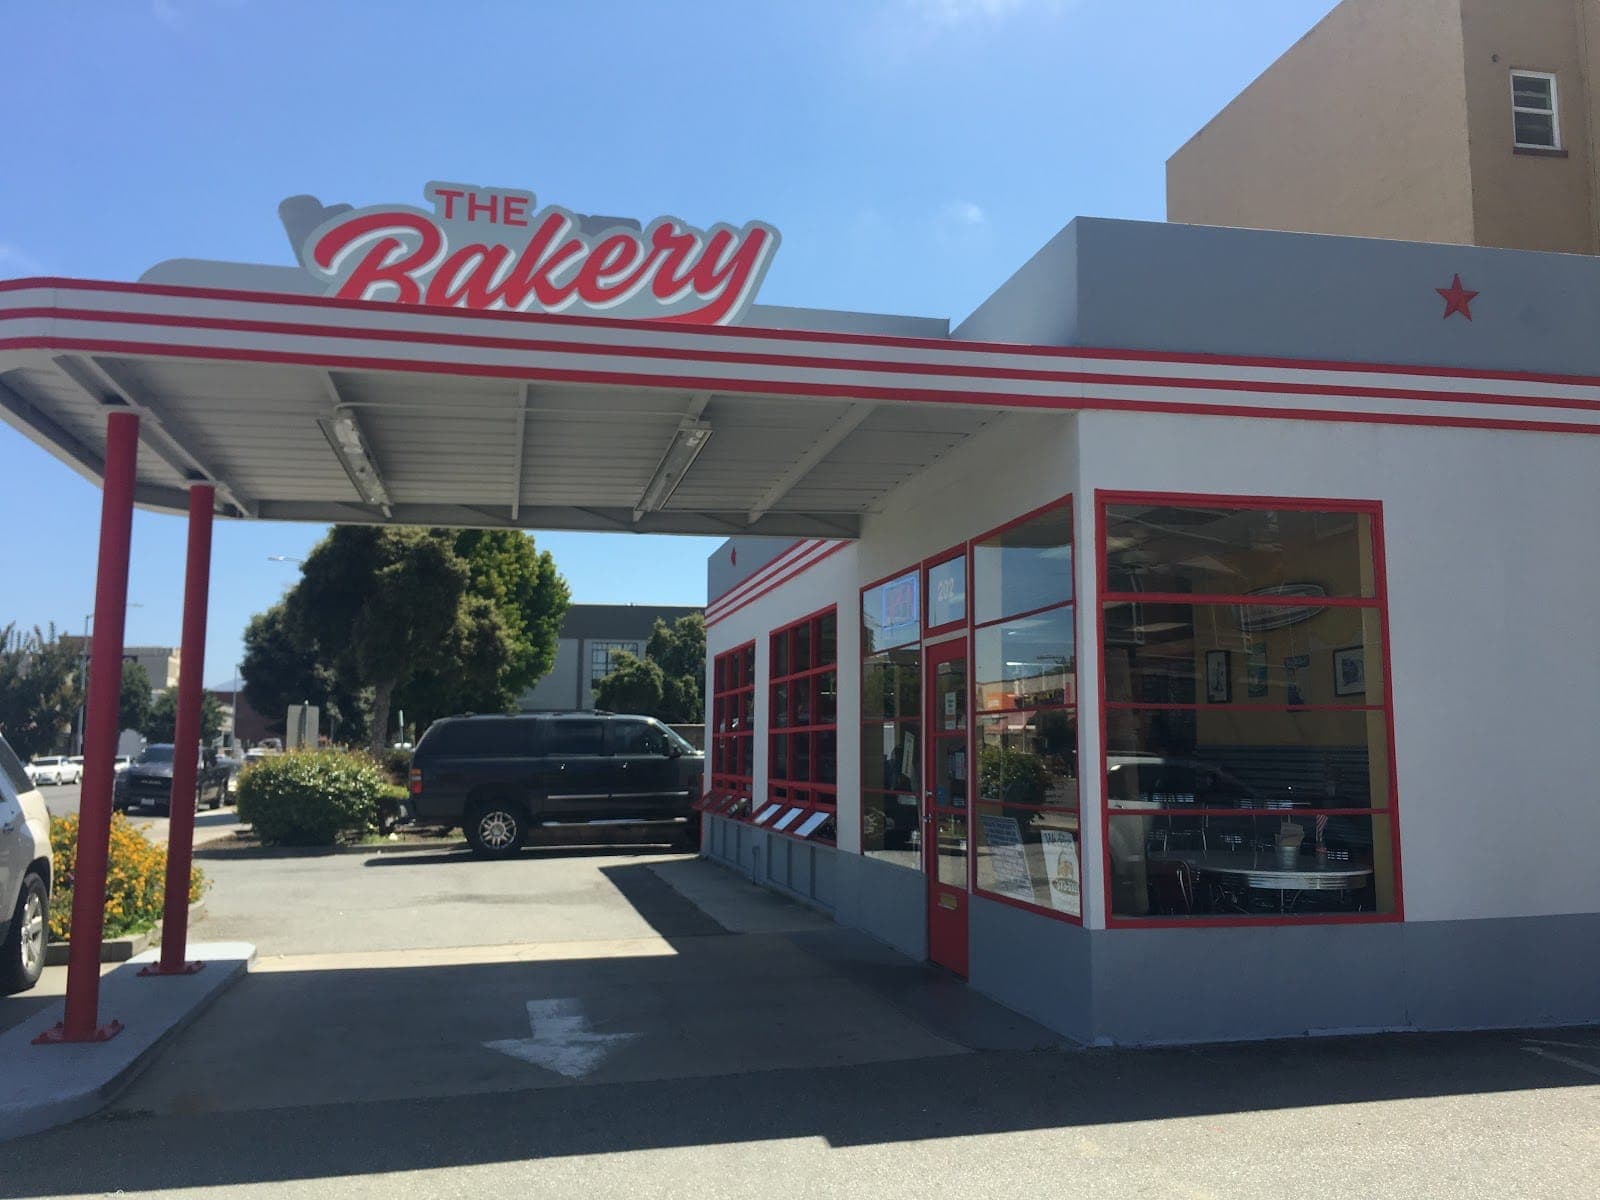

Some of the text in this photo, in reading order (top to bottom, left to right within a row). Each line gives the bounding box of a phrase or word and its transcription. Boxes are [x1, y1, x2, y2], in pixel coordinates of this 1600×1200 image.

[434, 188, 529, 227] THE
[313, 212, 773, 326] Bakery
[936, 577, 955, 602] 202
